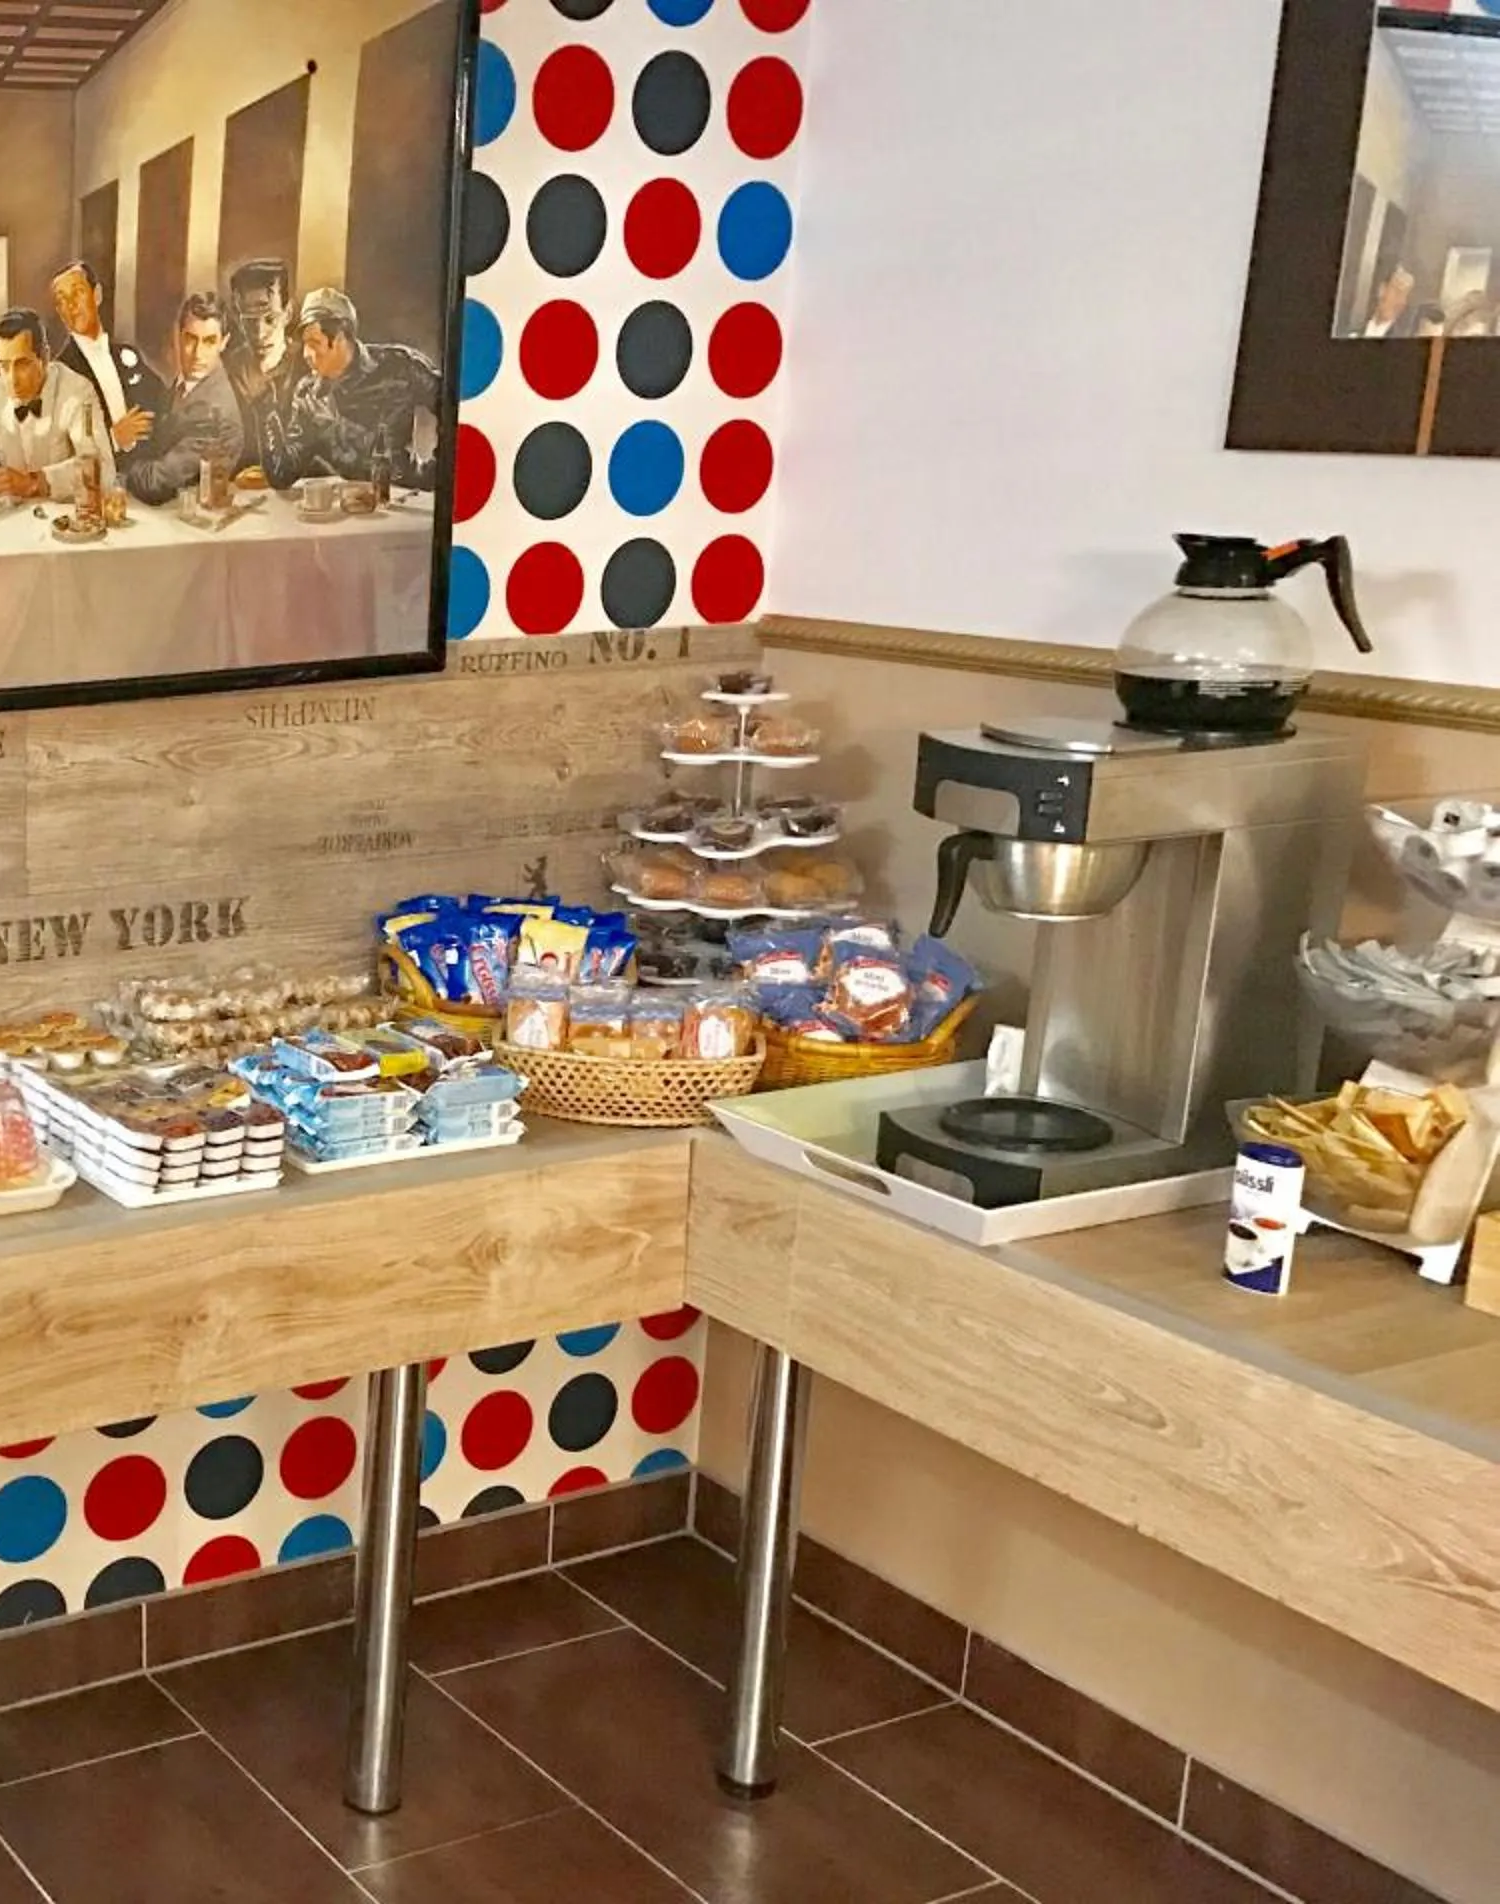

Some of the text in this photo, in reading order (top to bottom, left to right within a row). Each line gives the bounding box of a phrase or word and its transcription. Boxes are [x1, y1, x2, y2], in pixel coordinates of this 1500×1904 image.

[460, 650, 568, 674] RUFFINO
[243, 696, 376, 729] MEMPHIS
[108, 895, 251, 951] YORK
